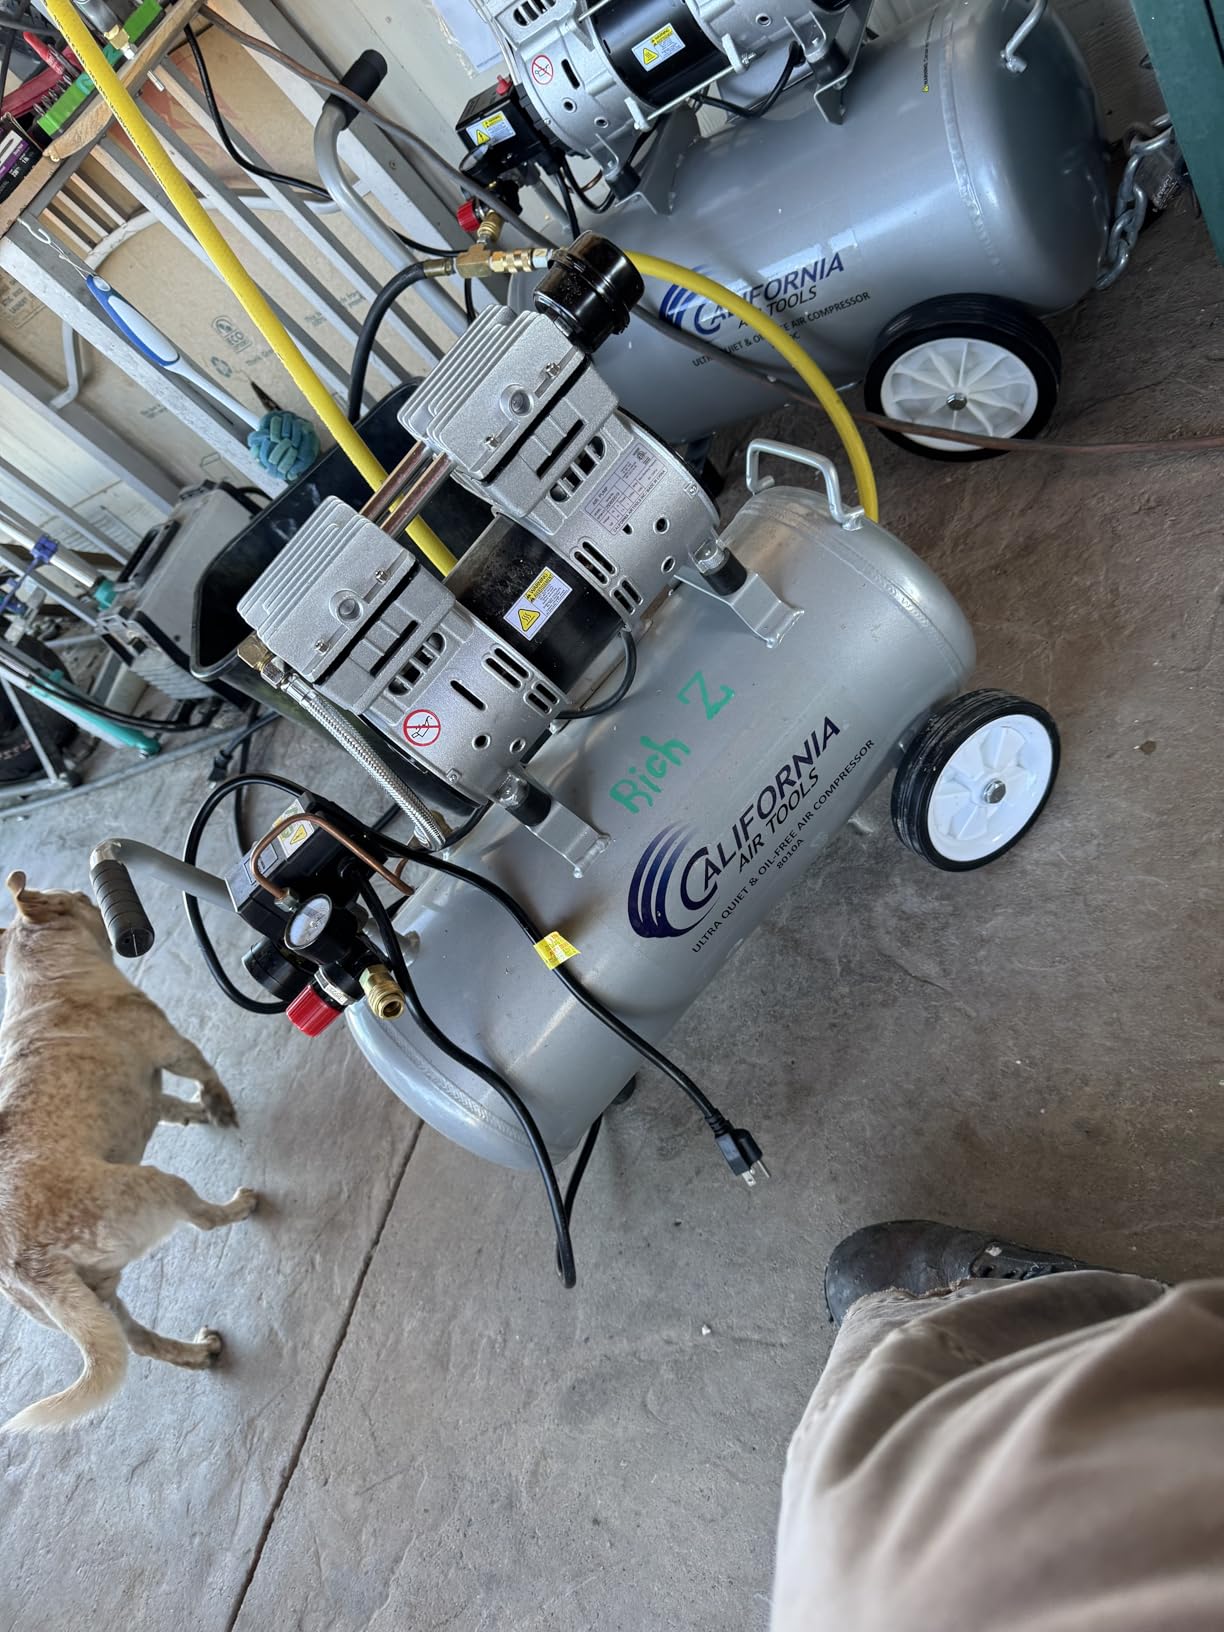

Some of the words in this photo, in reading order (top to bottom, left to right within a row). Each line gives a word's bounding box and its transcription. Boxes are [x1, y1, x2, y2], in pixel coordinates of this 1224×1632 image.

[693, 252, 844, 335] CAFORNIA
[743, 338, 752, 347] &
[791, 317, 806, 329] AIR
[807, 292, 871, 322] COMPRESSOR
[767, 285, 817, 316] TOOLS
[609, 736, 691, 814] Rich
[680, 716, 841, 911] CALIFORNIA
[692, 920, 722, 953] ULTRA
[721, 885, 749, 918] QUIET
[748, 875, 760, 887] &
[758, 831, 798, 875] OIL-FREE
[797, 811, 814, 831] AIR
[813, 739, 875, 811] COMPRESSOR
[738, 832, 766, 873] AIR
[765, 767, 820, 834] TOOLS
[776, 838, 805, 869] 8010A
